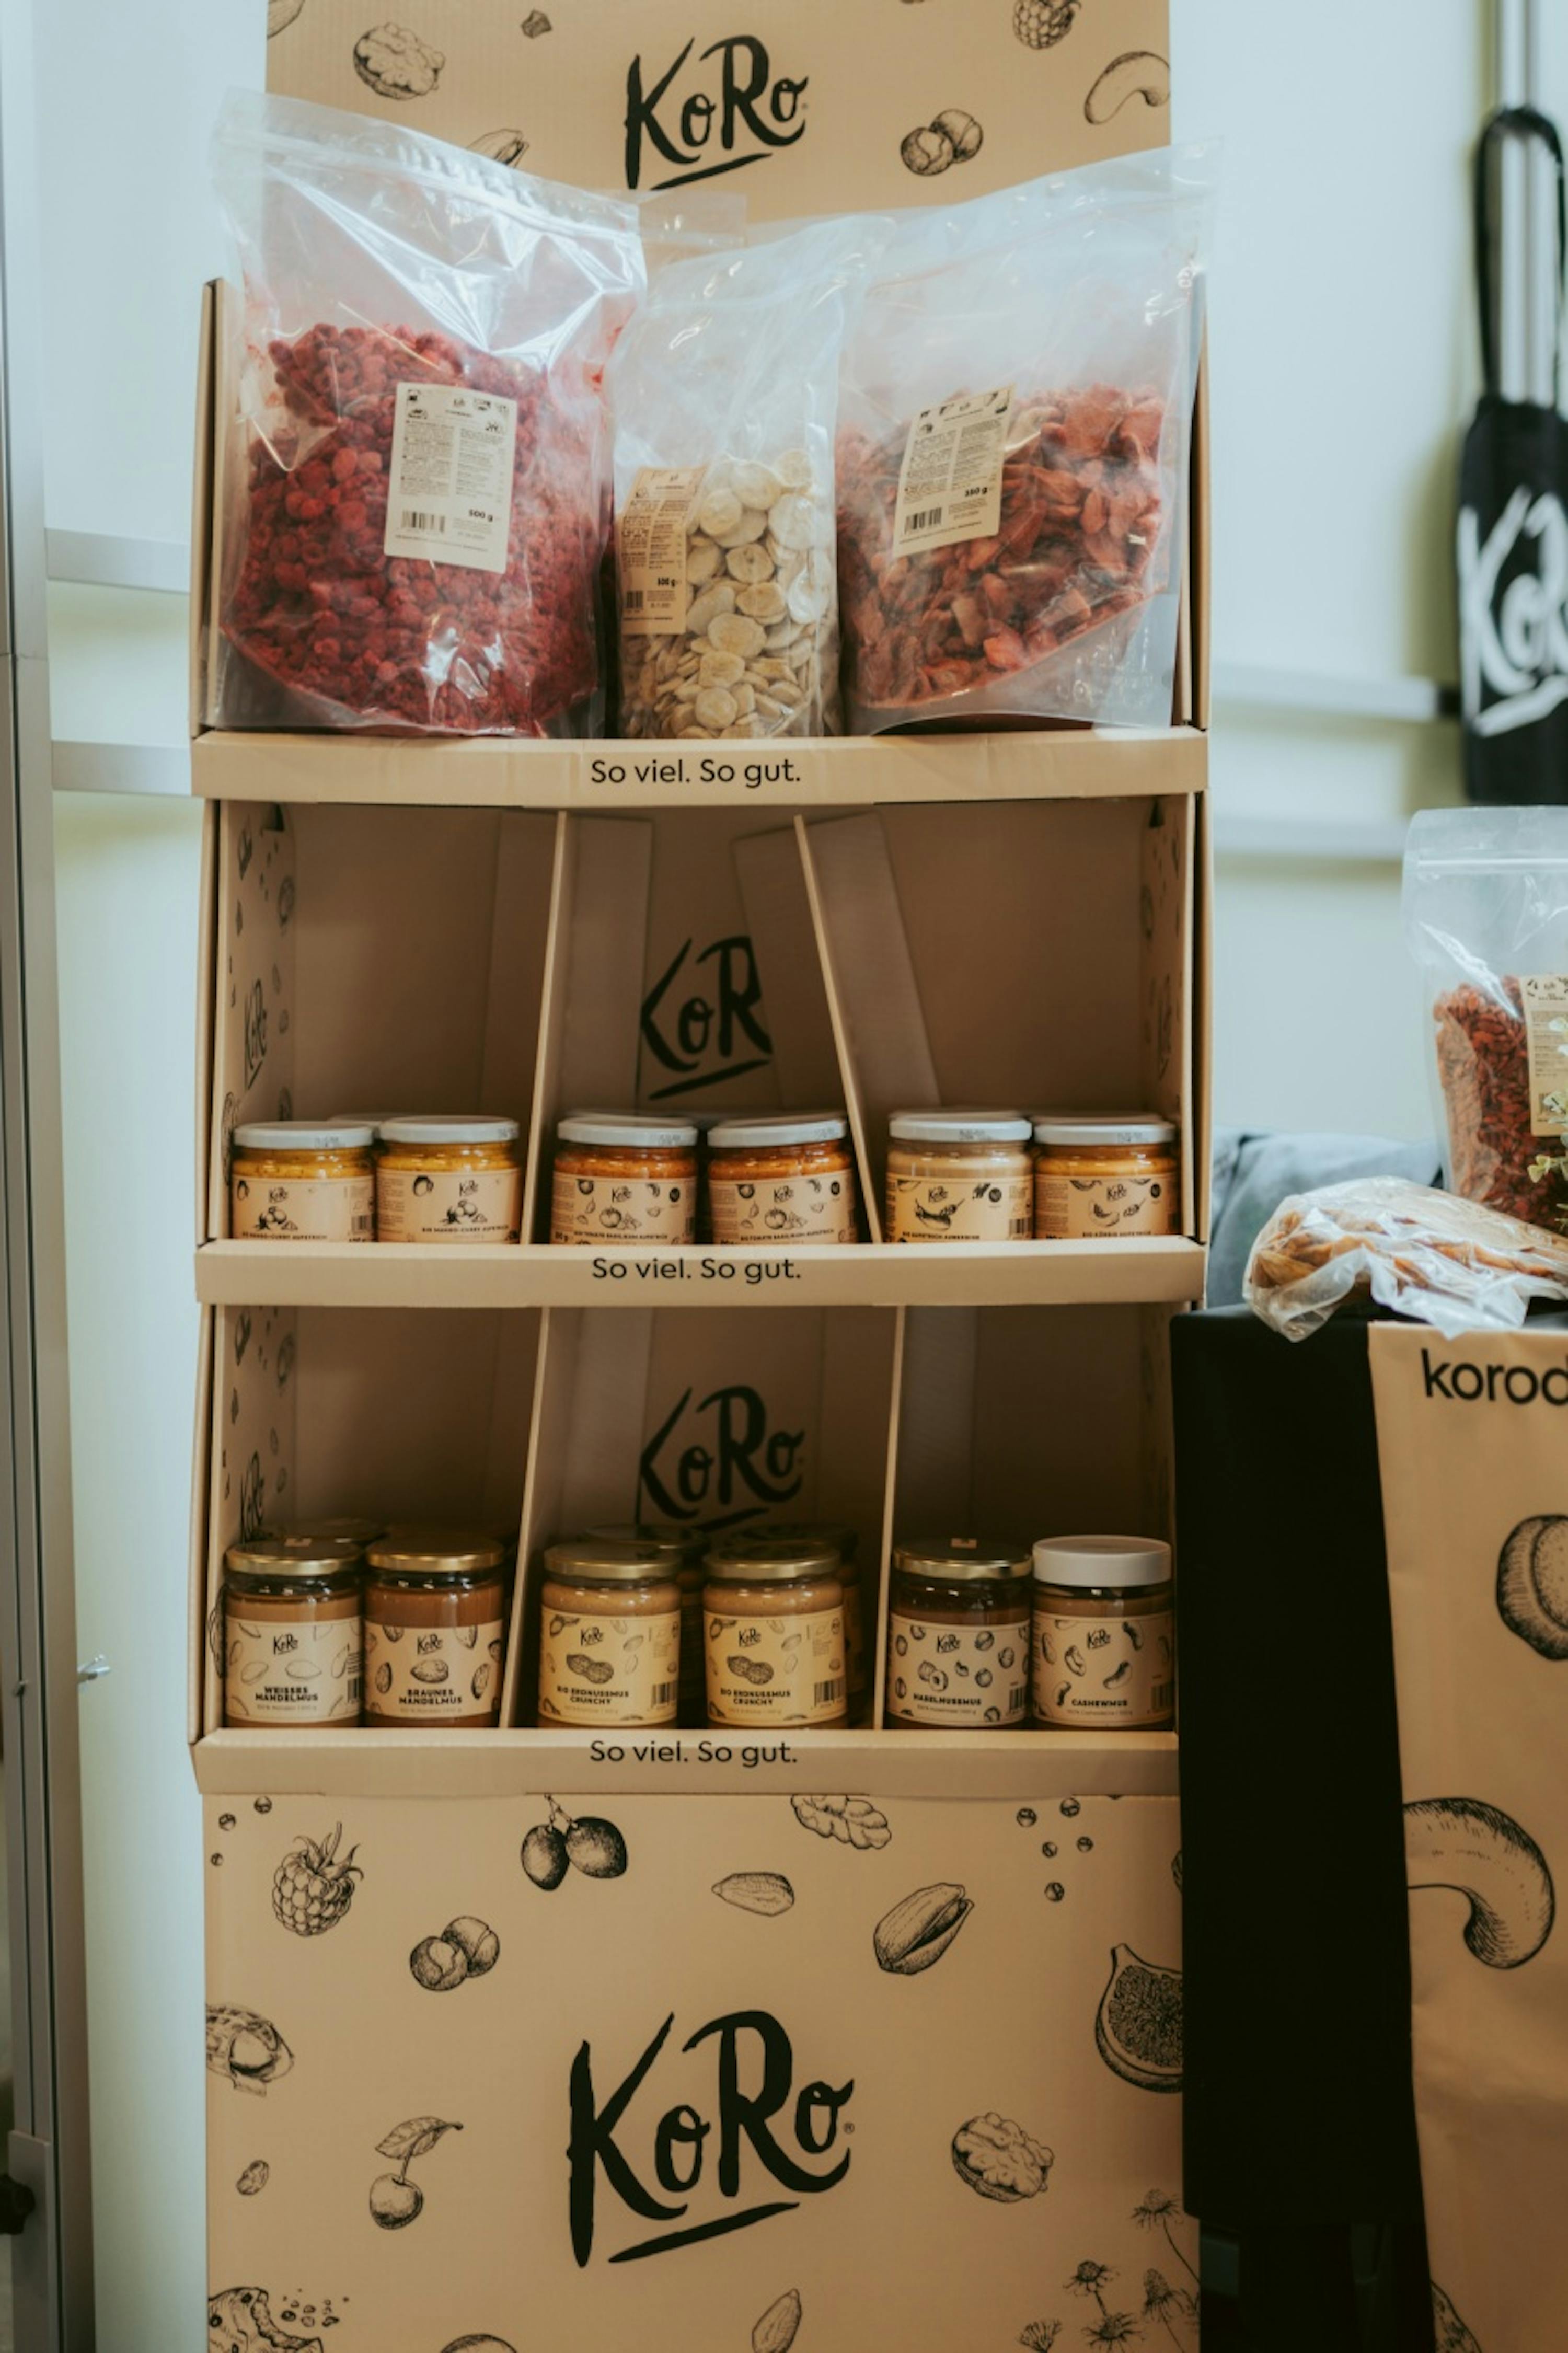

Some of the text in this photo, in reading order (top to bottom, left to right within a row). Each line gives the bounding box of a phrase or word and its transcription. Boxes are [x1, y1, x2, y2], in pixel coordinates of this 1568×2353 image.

[624, 35, 808, 190] KoRo
[591, 759, 801, 789] So viel. So gut.
[592, 1258, 801, 1284] So viel. So gut.
[273, 1633, 299, 1655] KoRo
[418, 1634, 443, 1655] KoRo
[581, 1627, 604, 1646] KoRo
[739, 1627, 762, 1647] KoRo
[936, 1634, 961, 1653] KoRo
[1087, 1629, 1112, 1650] KoRo
[256, 1693, 318, 1702] MANDELMUS
[570, 1695, 612, 1704] CRUNCHY
[590, 1740, 798, 1768] So viel. So gut.
[566, 2010, 855, 2268] KoRo
